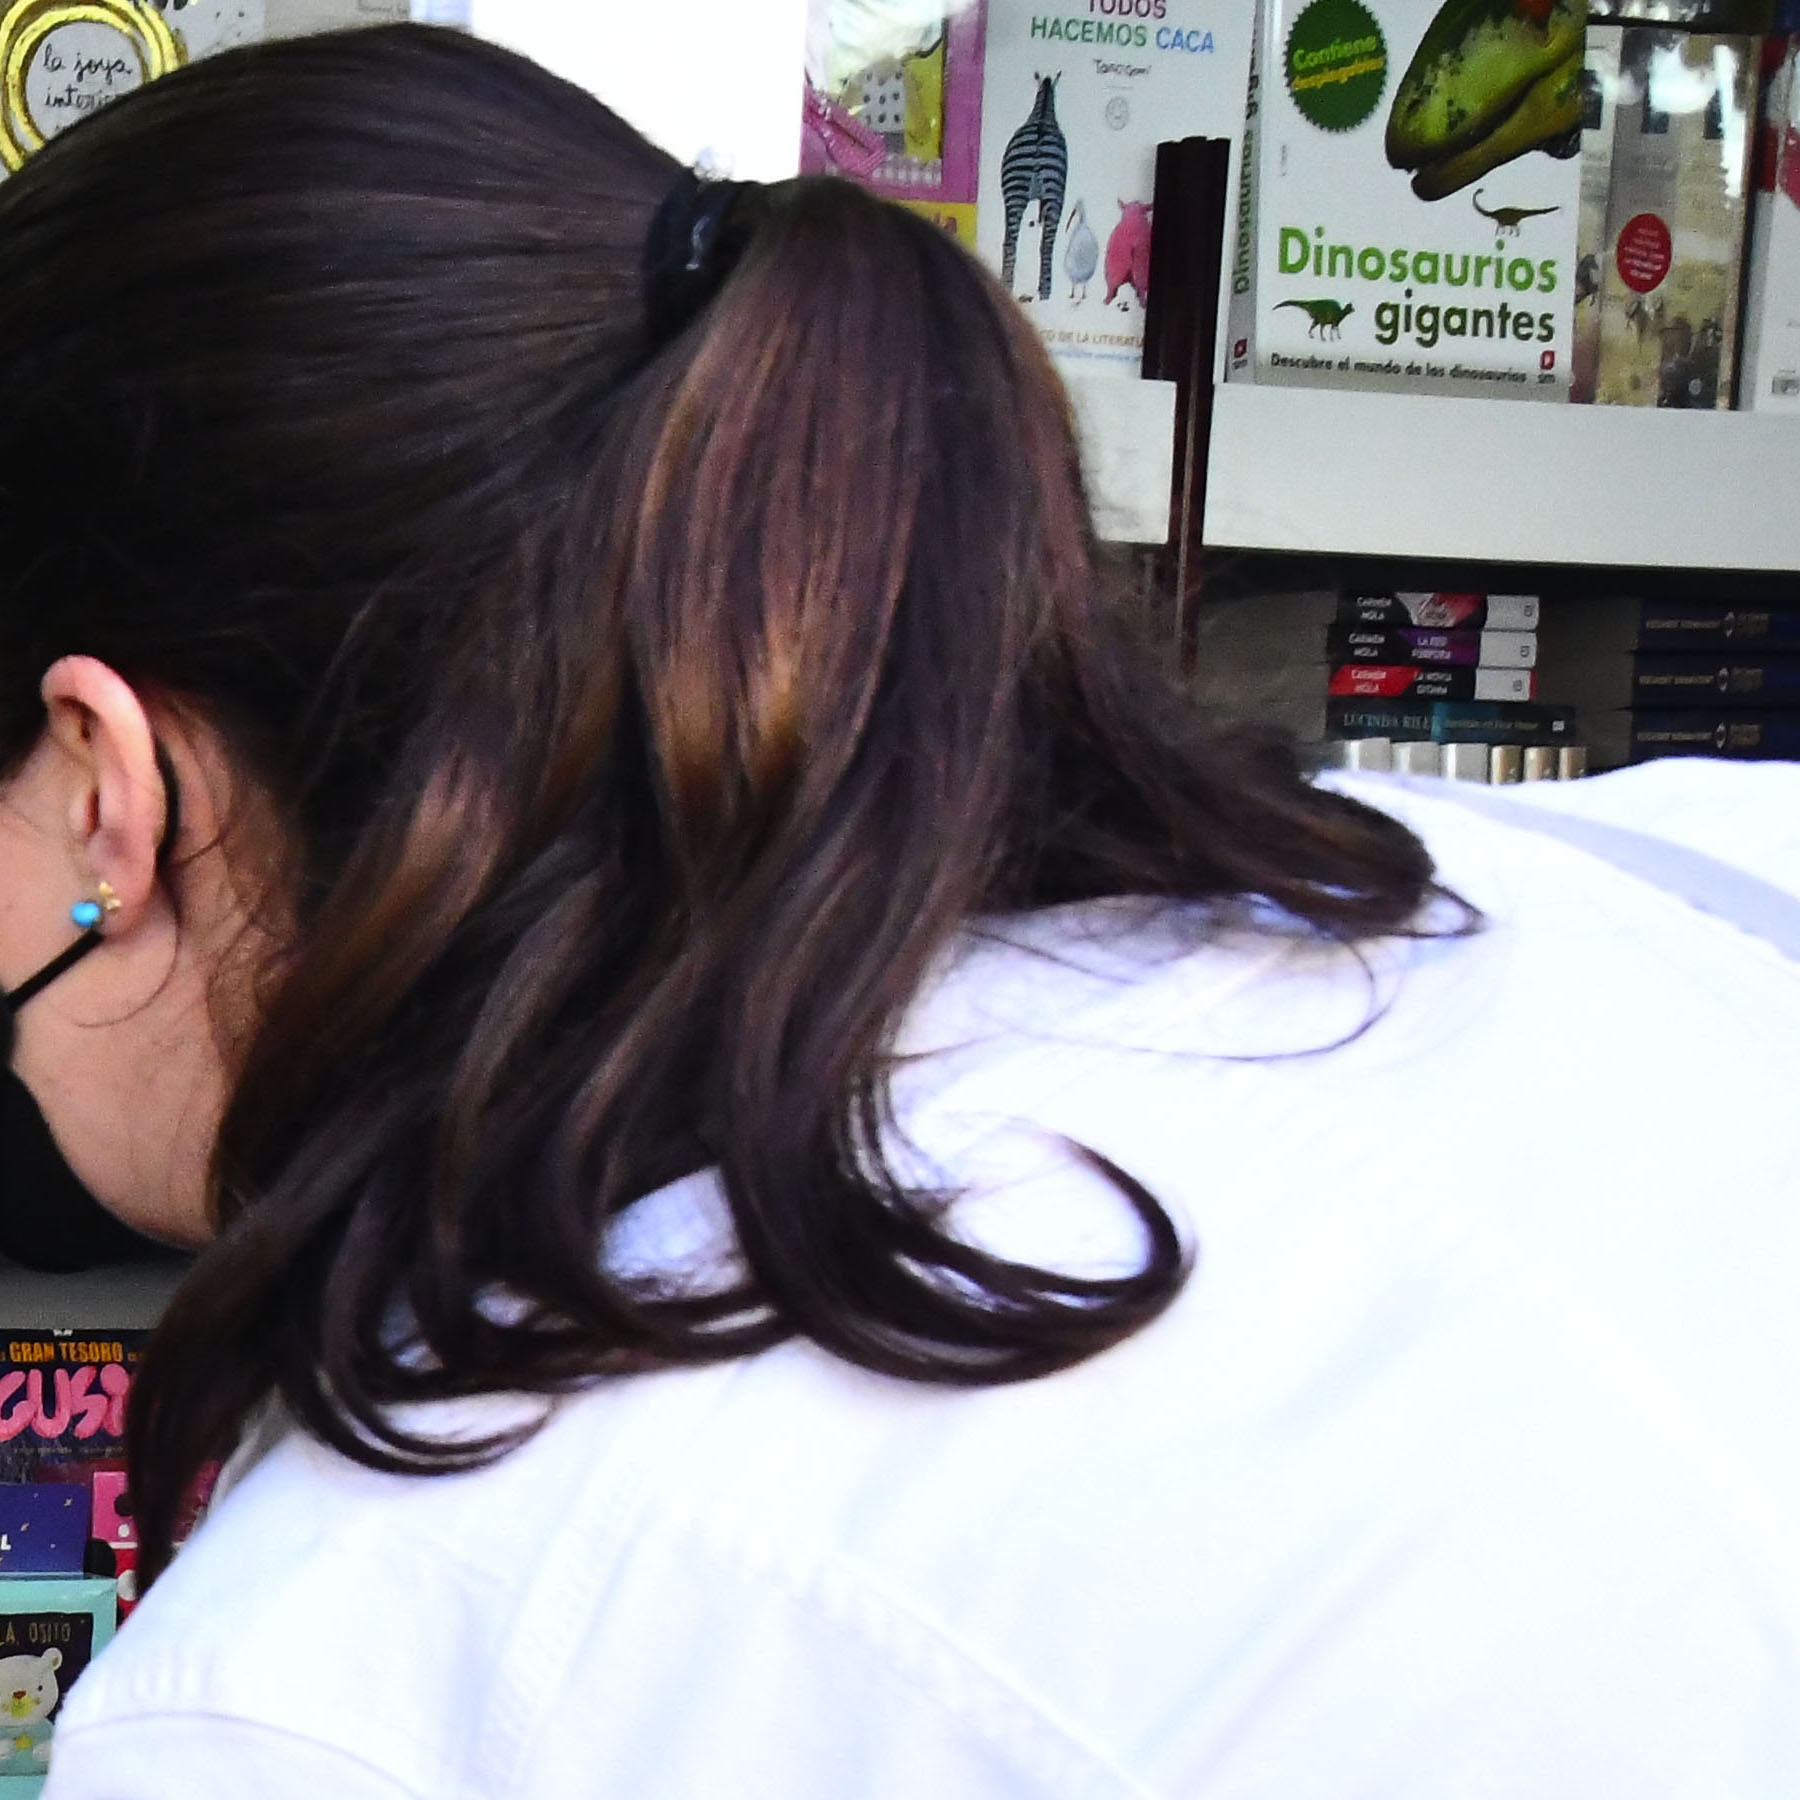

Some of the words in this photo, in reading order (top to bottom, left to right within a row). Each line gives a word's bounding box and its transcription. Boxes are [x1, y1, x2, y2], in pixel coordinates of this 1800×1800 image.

[1031, 17, 1147, 47] HACEMOS
[1156, 27, 1215, 54] CACA
[1278, 226, 1558, 293] Dinosaurios
[1375, 288, 1555, 348] gigantes
[1271, 353, 1332, 371] Descubre
[1354, 357, 1399, 375] mundo
[1405, 359, 1423, 376] de
[1425, 360, 1446, 377] los
[1449, 363, 1527, 383] dinosaurios
[9, 1342, 54, 1362] GRAN
[59, 1342, 122, 1362] TESORO
[29, 1622, 71, 1643] OSITO
